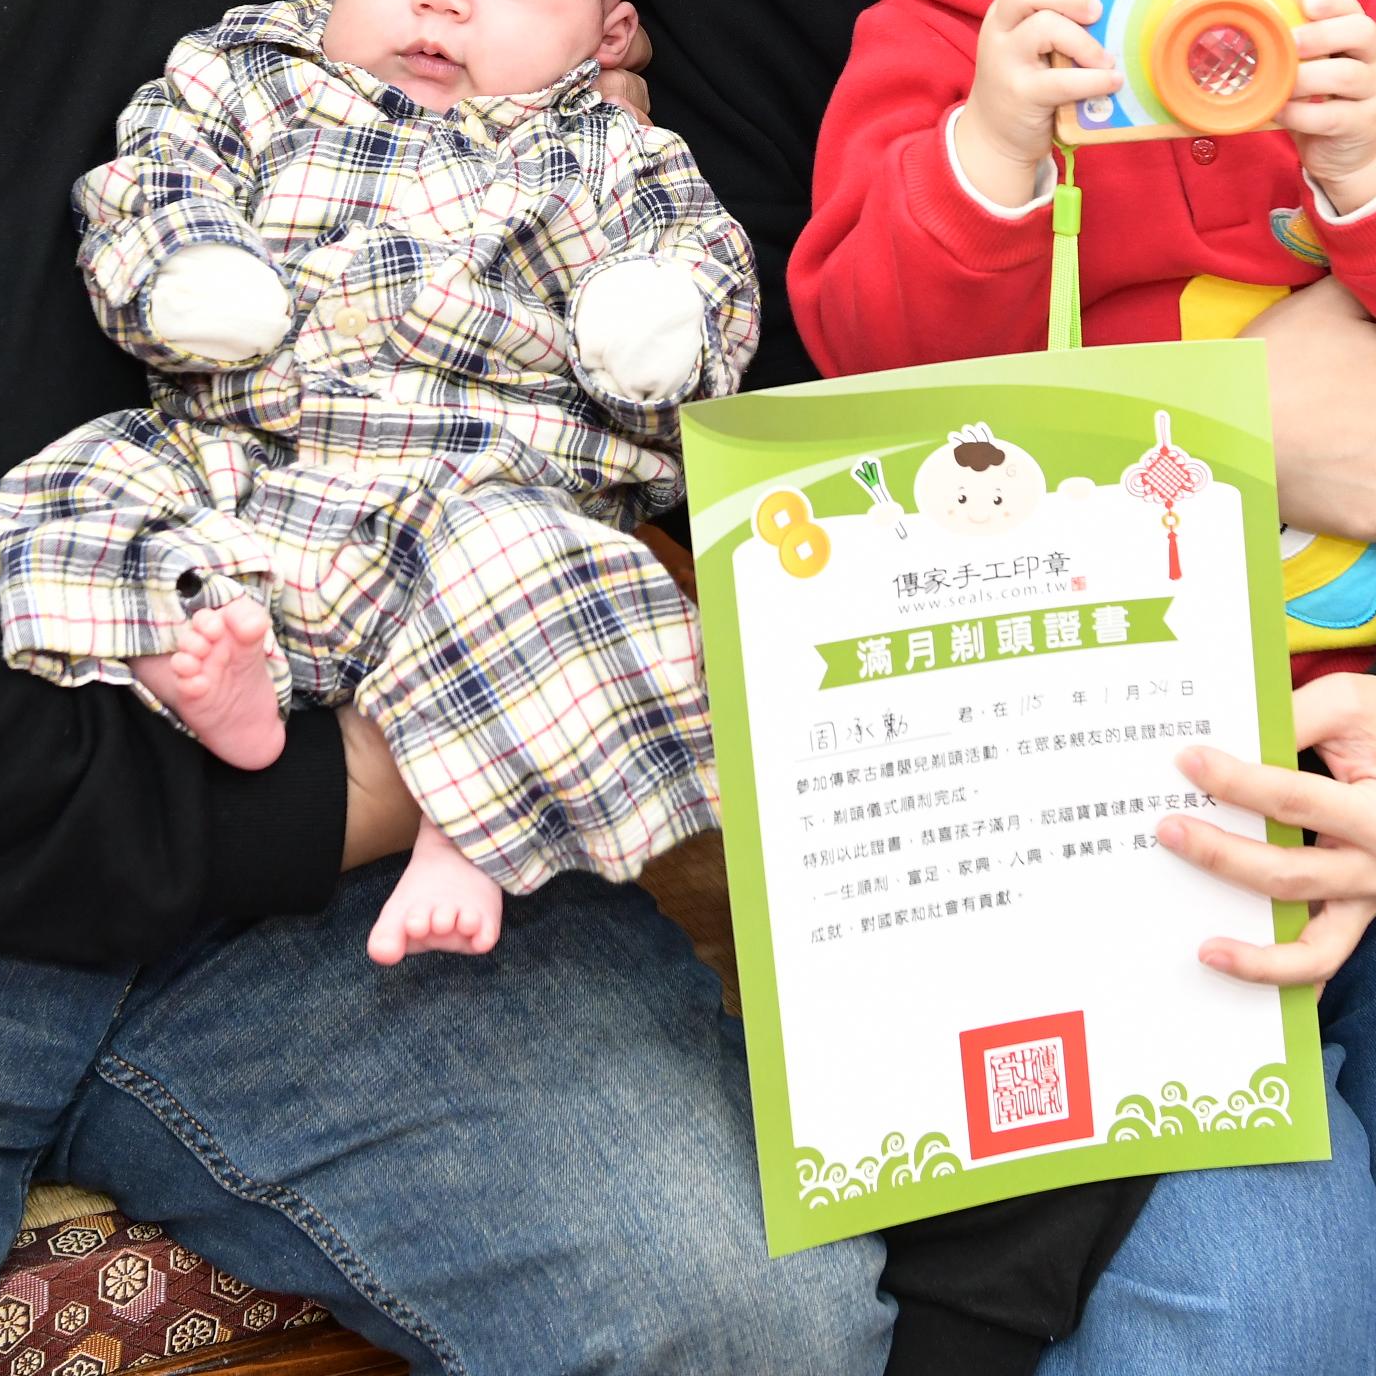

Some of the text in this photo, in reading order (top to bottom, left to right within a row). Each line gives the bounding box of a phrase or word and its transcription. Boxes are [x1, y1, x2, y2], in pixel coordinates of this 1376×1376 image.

[892, 552, 1071, 599] 傳家手工印章
[897, 580, 1068, 615] www.seals.com.tw
[856, 605, 1131, 679] 滿月剃頭證書
[1071, 690, 1088, 705] 年
[1125, 684, 1141, 702] 月
[1180, 679, 1195, 697] 日
